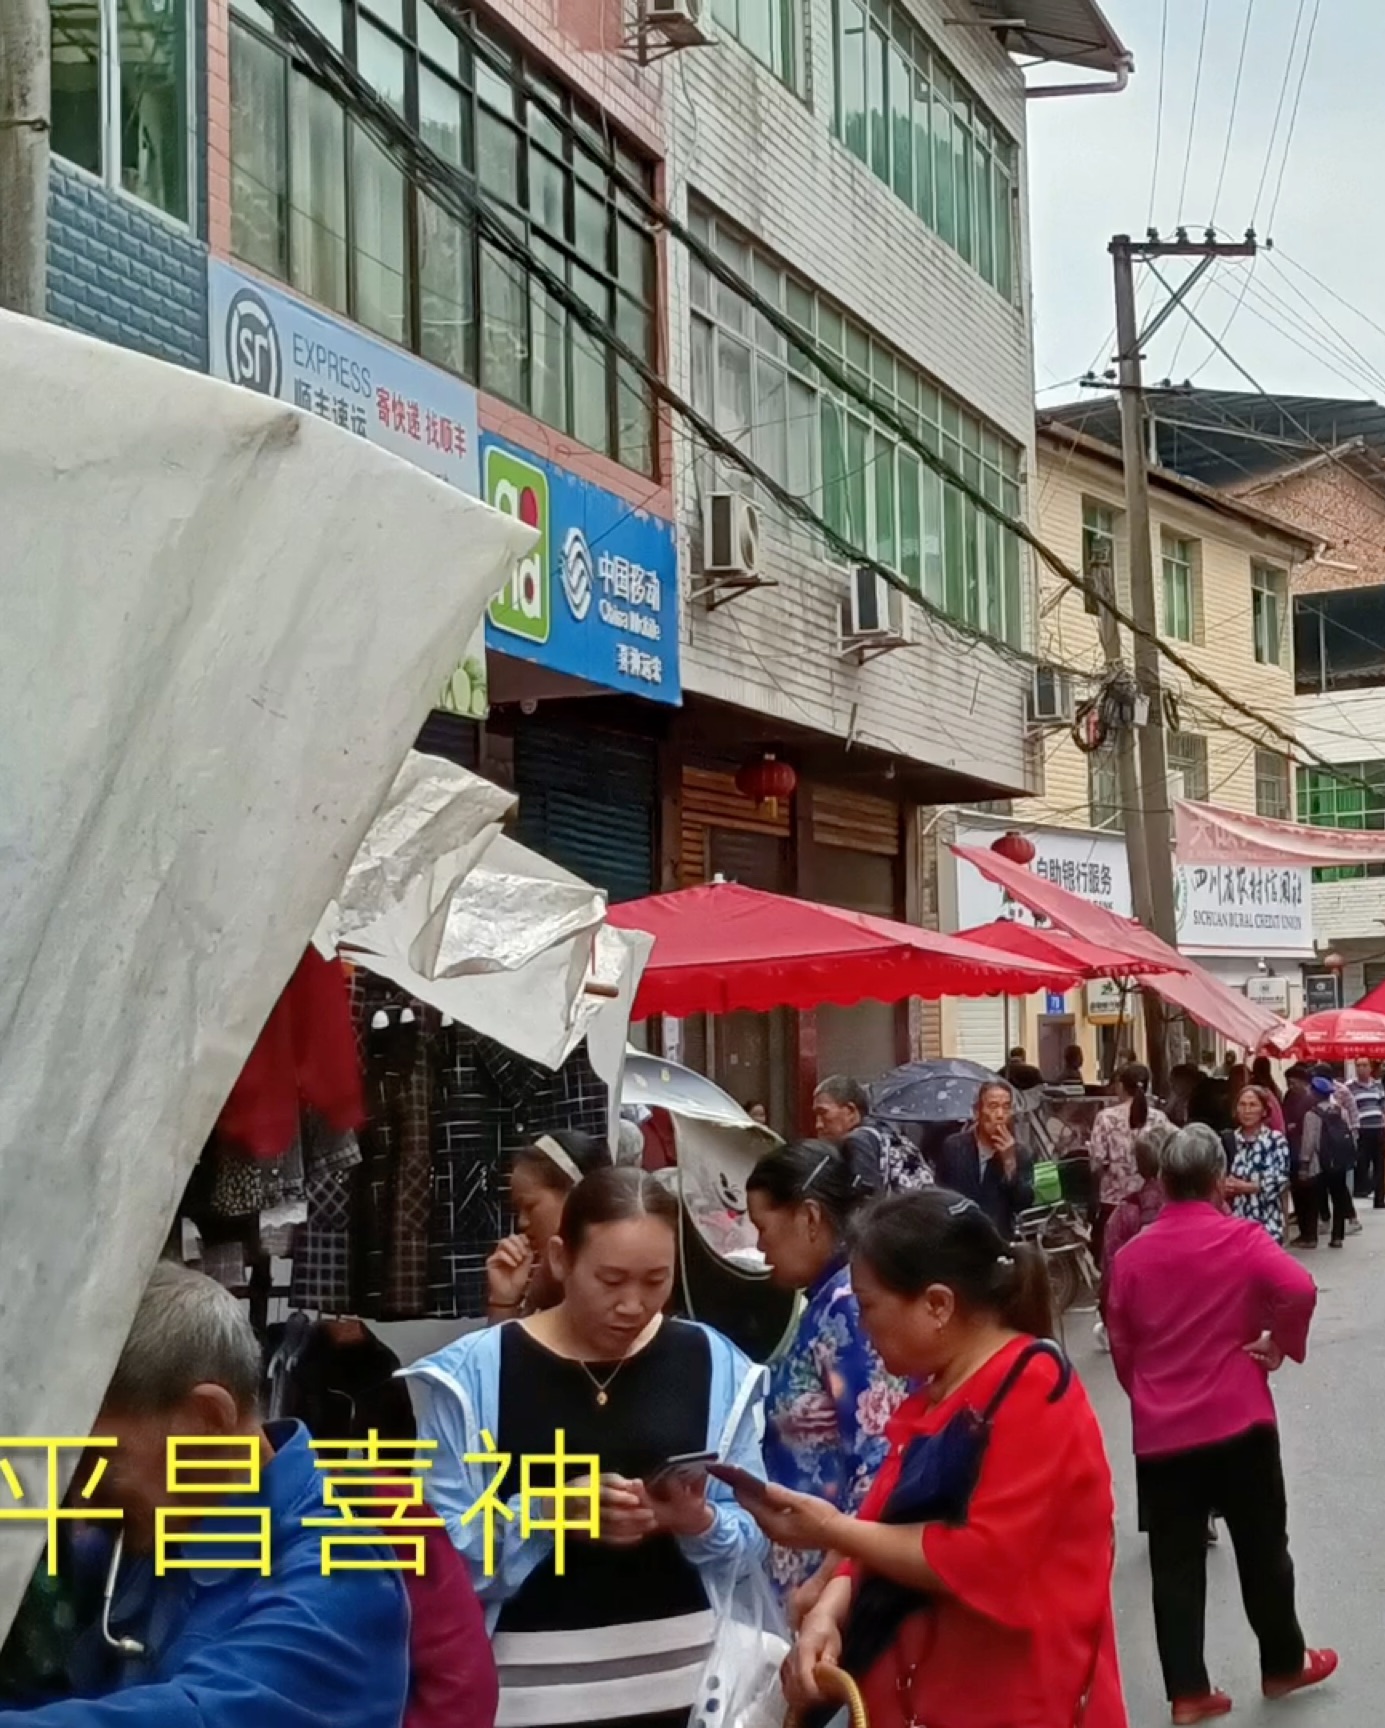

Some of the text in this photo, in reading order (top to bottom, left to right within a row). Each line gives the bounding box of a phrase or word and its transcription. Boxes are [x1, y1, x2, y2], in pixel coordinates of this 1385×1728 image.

[292, 331, 373, 399] EXPRESS
[375, 386, 467, 459] 寄快递 找顺丰
[598, 550, 661, 612] 中国移动
